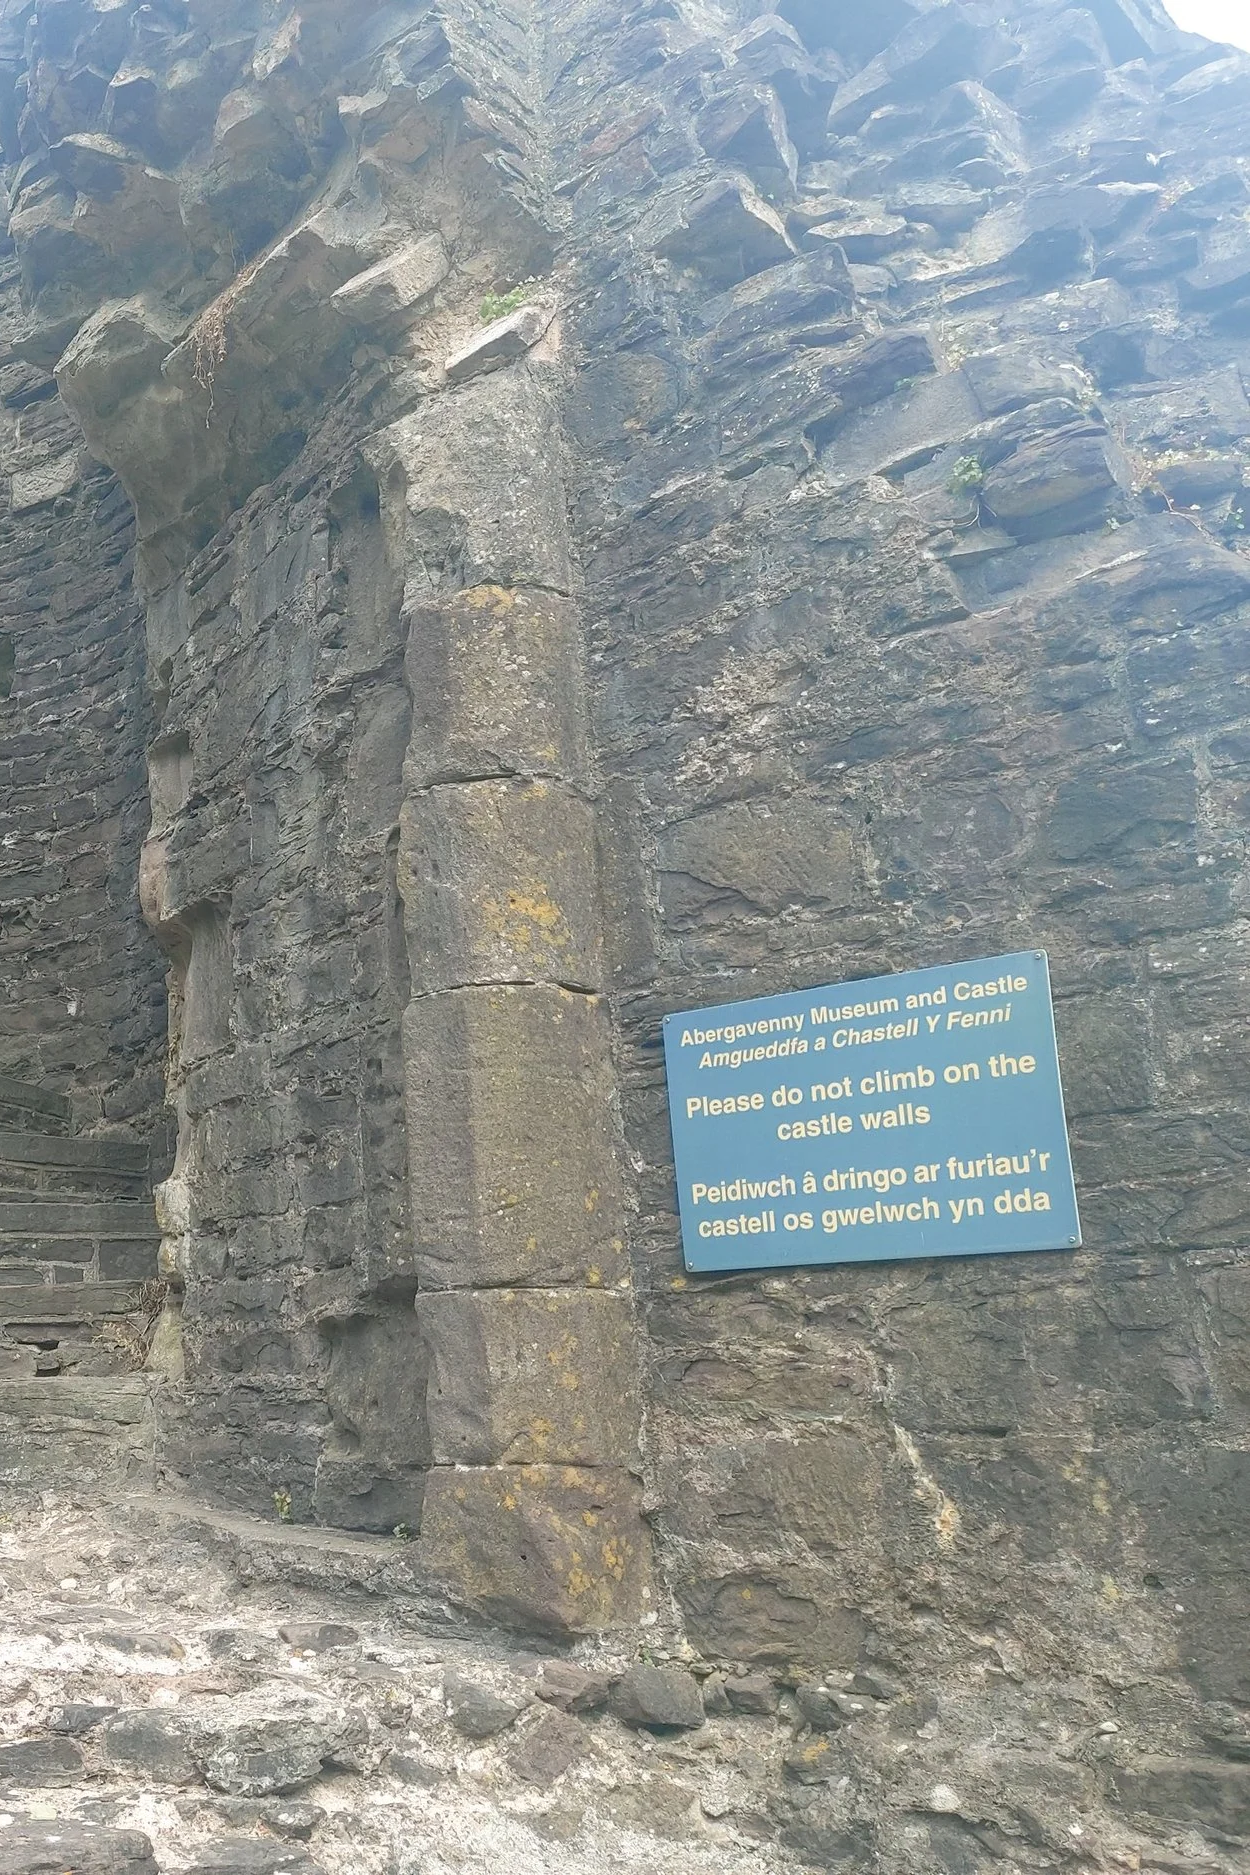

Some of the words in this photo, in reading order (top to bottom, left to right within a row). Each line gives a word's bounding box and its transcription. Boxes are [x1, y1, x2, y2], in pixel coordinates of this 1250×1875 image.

[680, 1013, 804, 1046] Abergavenny
[810, 999, 898, 1024] Museum
[906, 987, 947, 1008] and
[953, 976, 1028, 1000] Castle
[700, 1038, 809, 1068] Amgueddfa
[814, 1037, 826, 1050] a
[833, 1018, 919, 1048] Chastell
[926, 1016, 939, 1032] Y
[946, 1005, 1011, 1029] Fenni
[686, 1093, 764, 1118] Please
[772, 1086, 802, 1107] do
[811, 1077, 852, 1101] not
[860, 1066, 935, 1094] climb
[944, 1063, 980, 1084] on
[987, 1054, 1036, 1077] the
[778, 1113, 852, 1140] castle
[861, 1104, 930, 1129] walls
[692, 1176, 796, 1204] Peidiwch
[803, 1172, 817, 1193] â
[822, 1168, 907, 1192] dringo
[914, 1164, 939, 1184] ar
[698, 1212, 775, 1237] castell
[783, 1212, 814, 1231] os
[822, 1198, 940, 1233] gwelwch
[949, 1198, 984, 1224] yn
[994, 1189, 1051, 1214] dda
